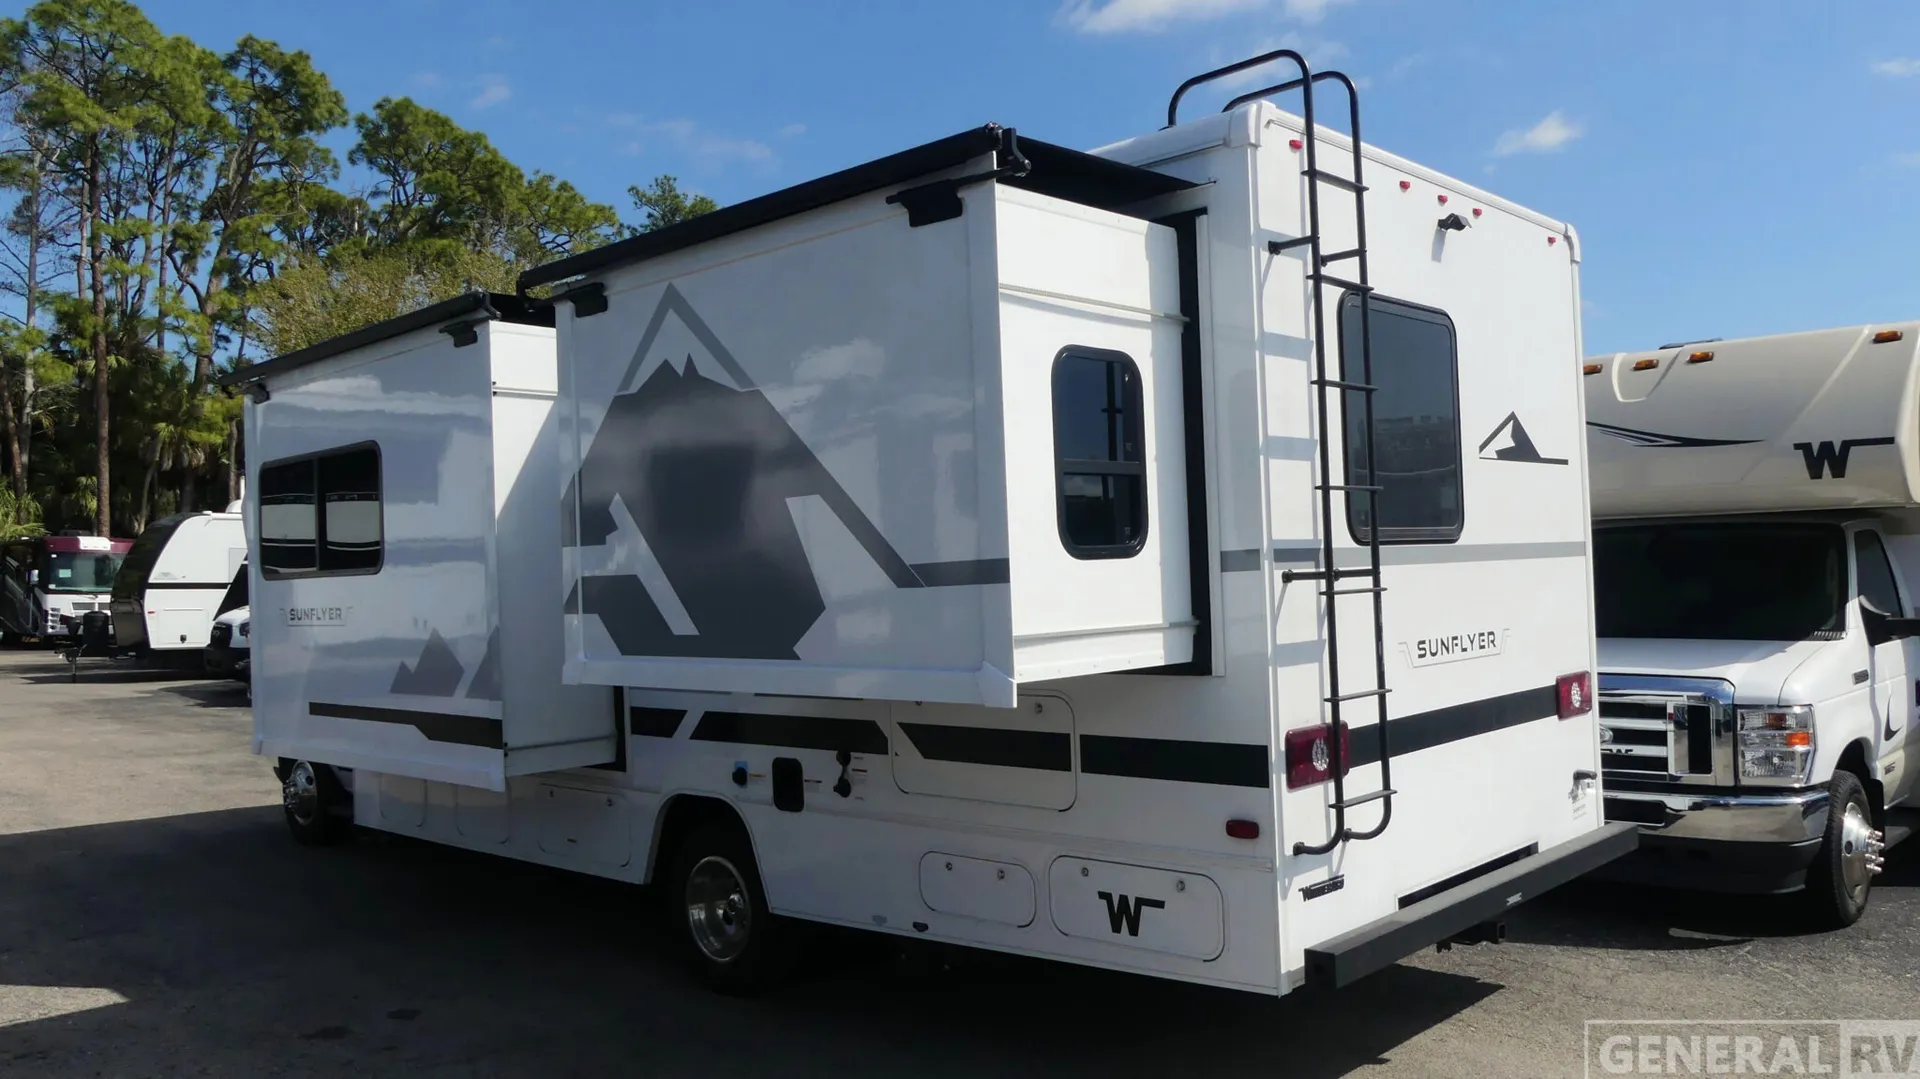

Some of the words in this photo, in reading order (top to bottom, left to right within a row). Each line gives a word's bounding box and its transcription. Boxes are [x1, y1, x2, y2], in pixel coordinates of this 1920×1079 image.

[1793, 436, 1895, 480] W
[289, 607, 343, 621] SUNFLYER
[1417, 630, 1497, 659] SUNFLYER
[1097, 890, 1166, 937] W
